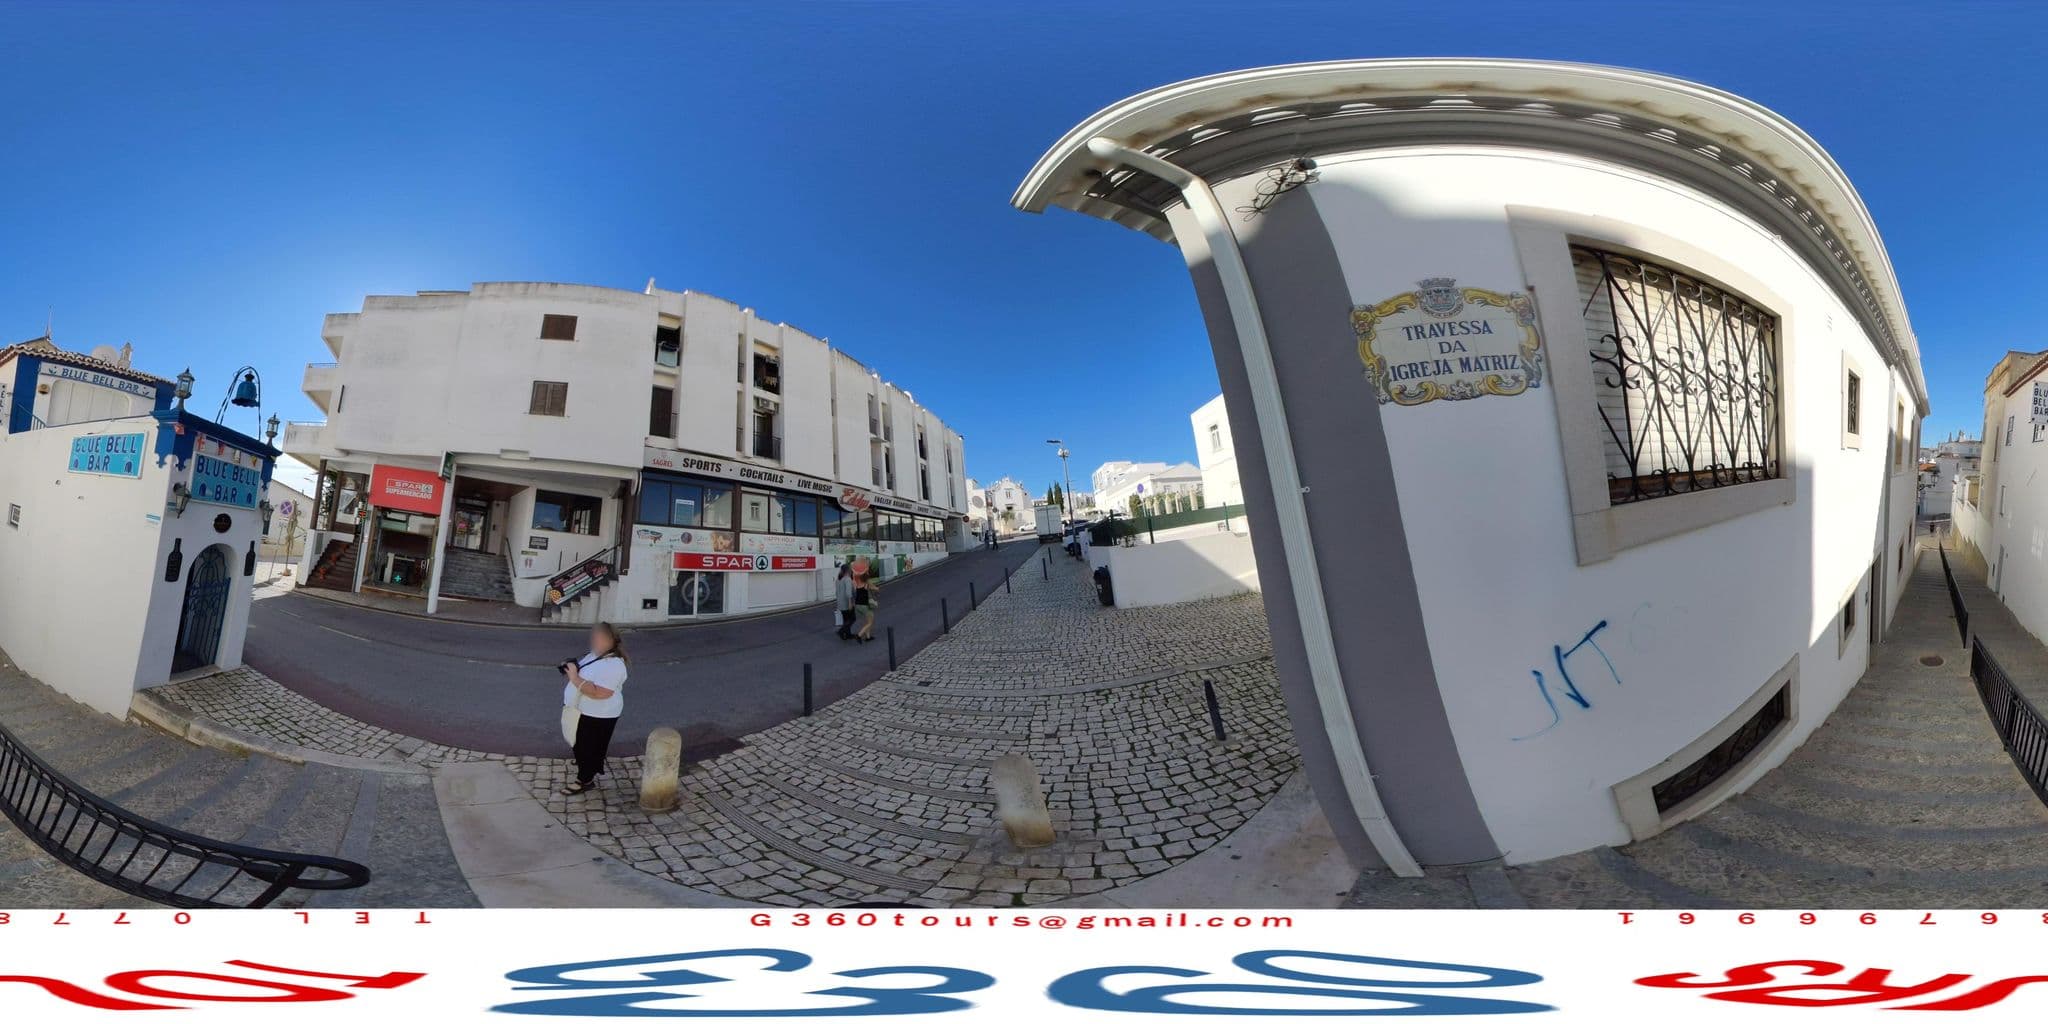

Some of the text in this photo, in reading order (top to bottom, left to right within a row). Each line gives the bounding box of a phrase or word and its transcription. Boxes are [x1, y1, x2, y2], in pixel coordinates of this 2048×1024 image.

[1402, 320, 1494, 341] TRAVESSA
[1438, 339, 1467, 354] DA
[1389, 354, 1520, 382] IGREJA MATRIZ
[61, 367, 140, 393] BLUE BELL BAR
[2033, 397, 2048, 407] BEL
[2034, 388, 2048, 398] BLU
[106, 436, 137, 454] BELL
[87, 454, 110, 471] BAR
[197, 455, 257, 486] BLUE BELL
[682, 457, 833, 494] SPORTS COCKTAILS LIVE MUSIC
[214, 484, 238, 503] BAR
[395, 481, 422, 490] SPAR
[702, 556, 753, 568] SPAR
